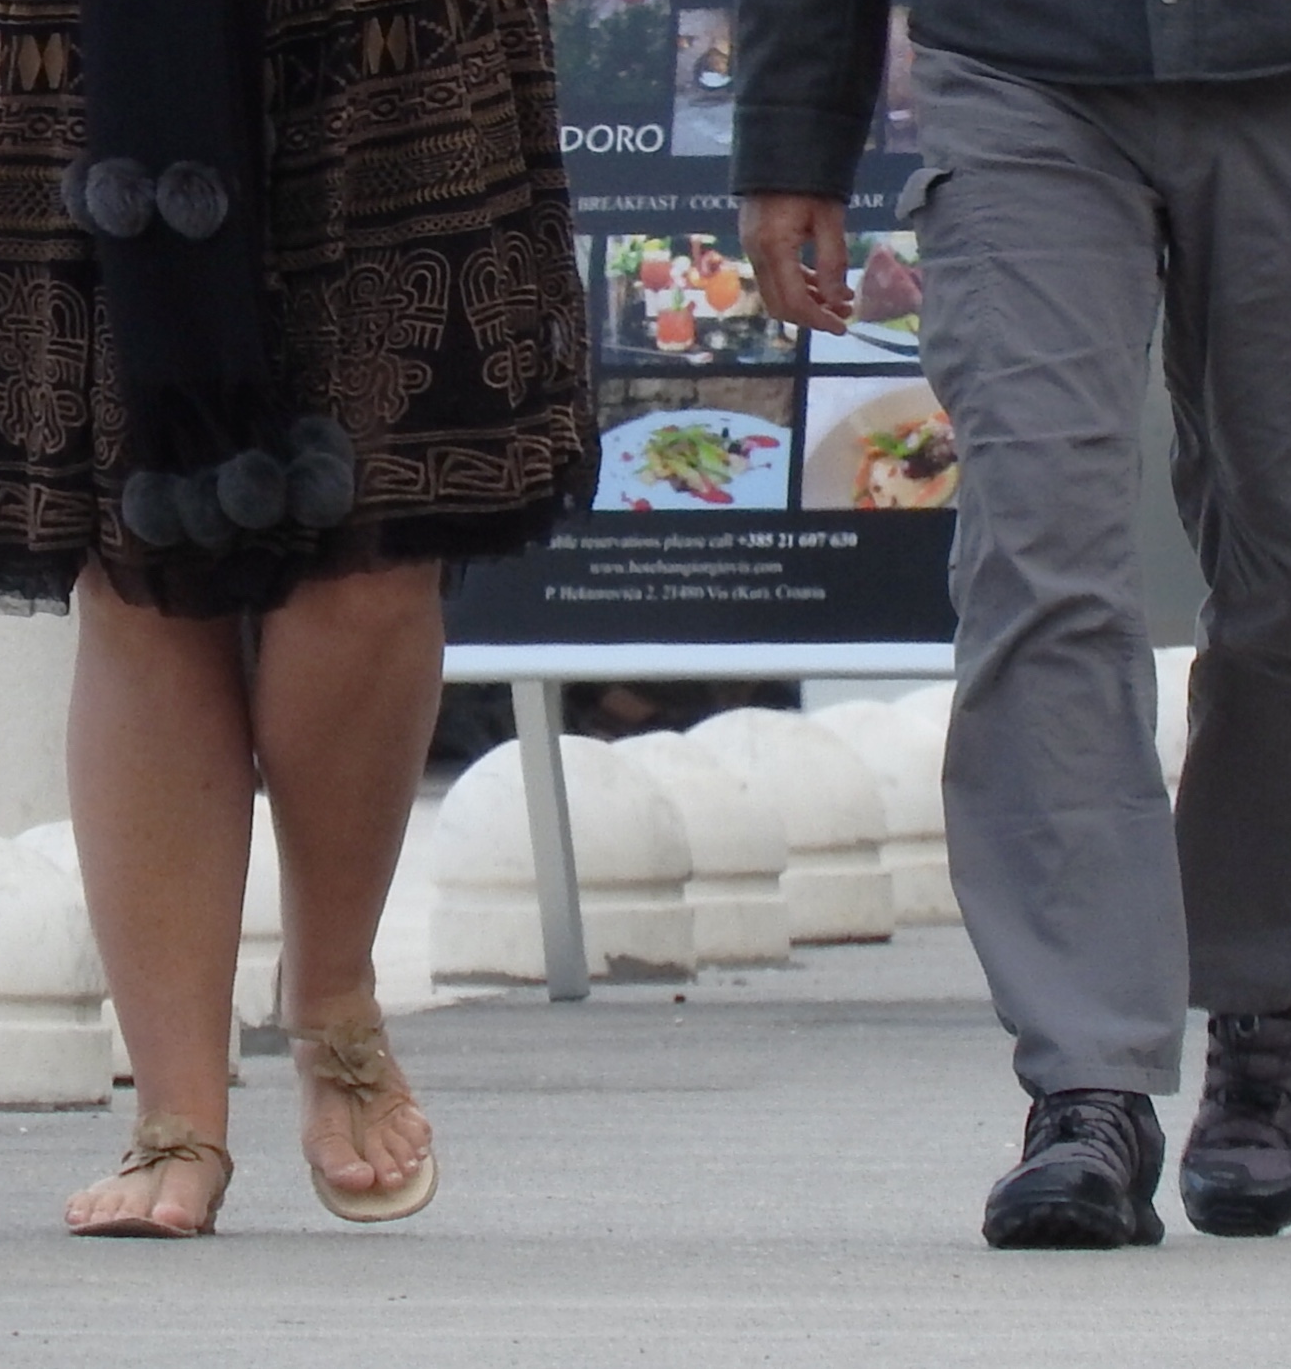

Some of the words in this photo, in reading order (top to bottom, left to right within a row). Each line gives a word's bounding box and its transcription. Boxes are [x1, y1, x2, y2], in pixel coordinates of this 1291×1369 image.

[560, 123, 665, 153] DORO
[577, 194, 680, 212] BREAKFAST
[689, 193, 738, 210] COCK
[778, 532, 794, 549] 21
